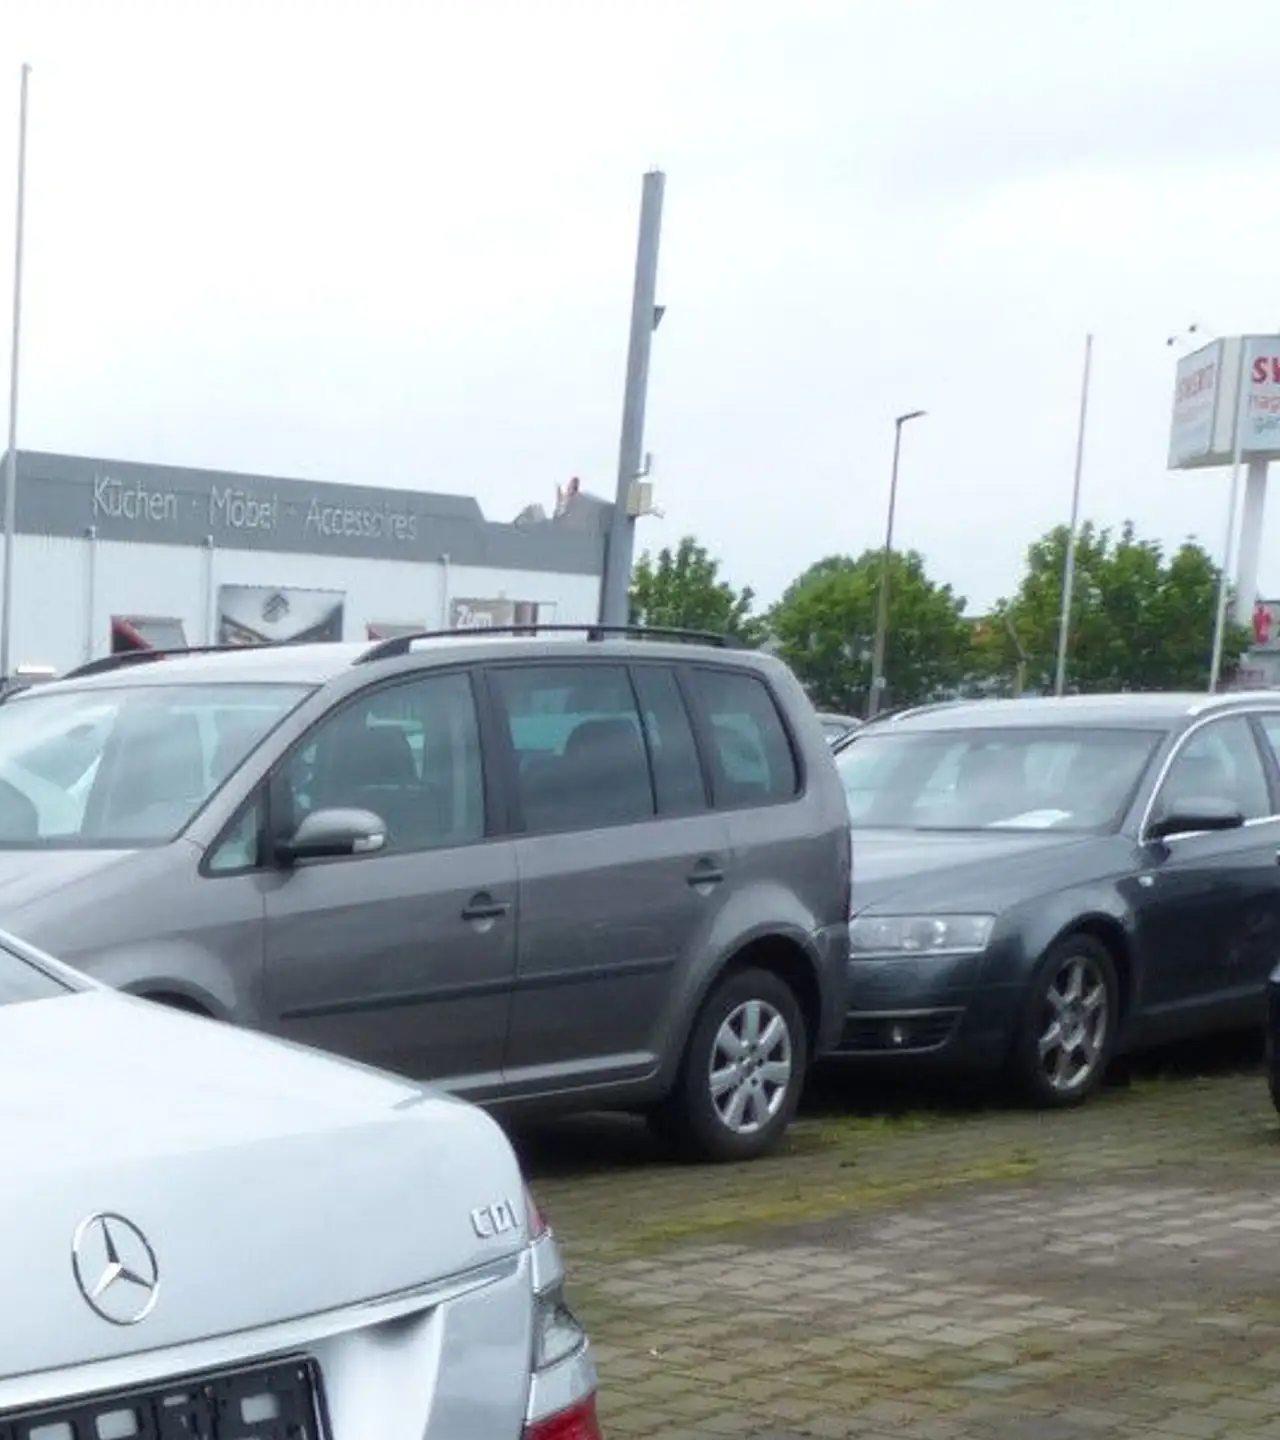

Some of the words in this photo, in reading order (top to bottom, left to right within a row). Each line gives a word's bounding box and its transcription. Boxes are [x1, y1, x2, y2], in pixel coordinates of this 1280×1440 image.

[93, 474, 177, 520] Küchen
[208, 483, 278, 529] Möbel
[305, 497, 417, 541] Accessoires
[470, 1199, 521, 1238] CDI
